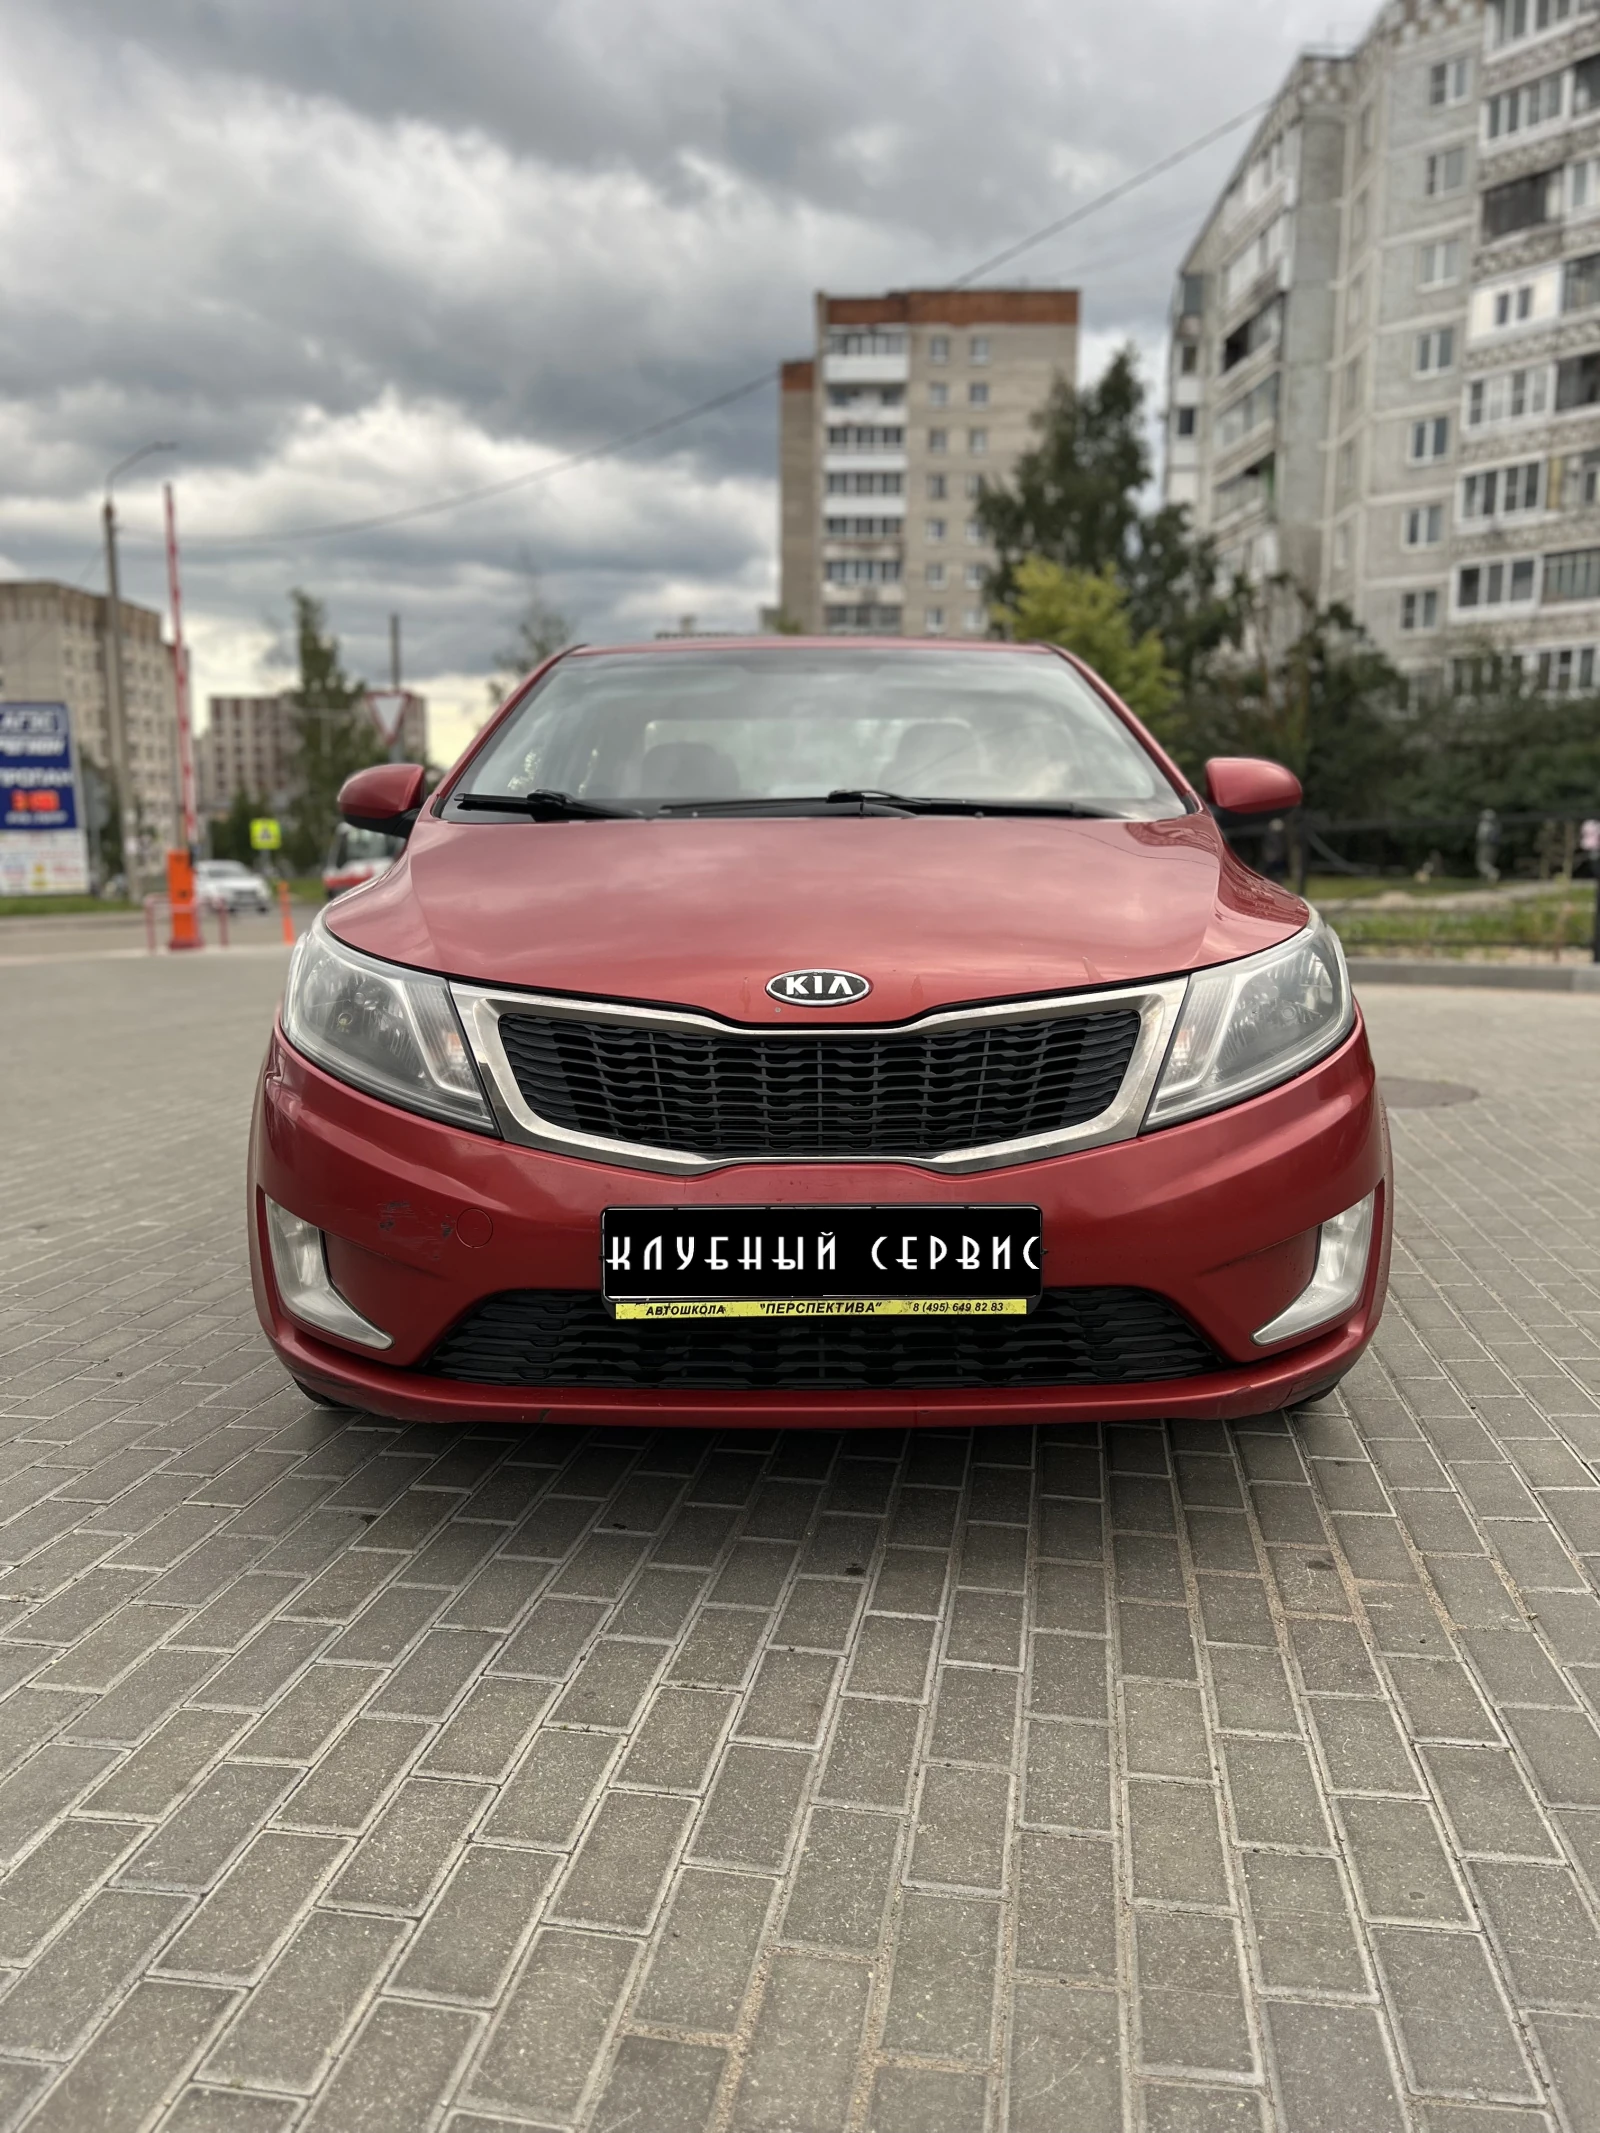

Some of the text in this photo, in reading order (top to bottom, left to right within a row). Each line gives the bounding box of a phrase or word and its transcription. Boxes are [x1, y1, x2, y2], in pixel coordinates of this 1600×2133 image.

[785, 975, 854, 995] KIA
[646, 1301, 1004, 1316] АВТОШКОЛА "ПЕРСПЕКТИВА" 8 (495) 649 82 83
